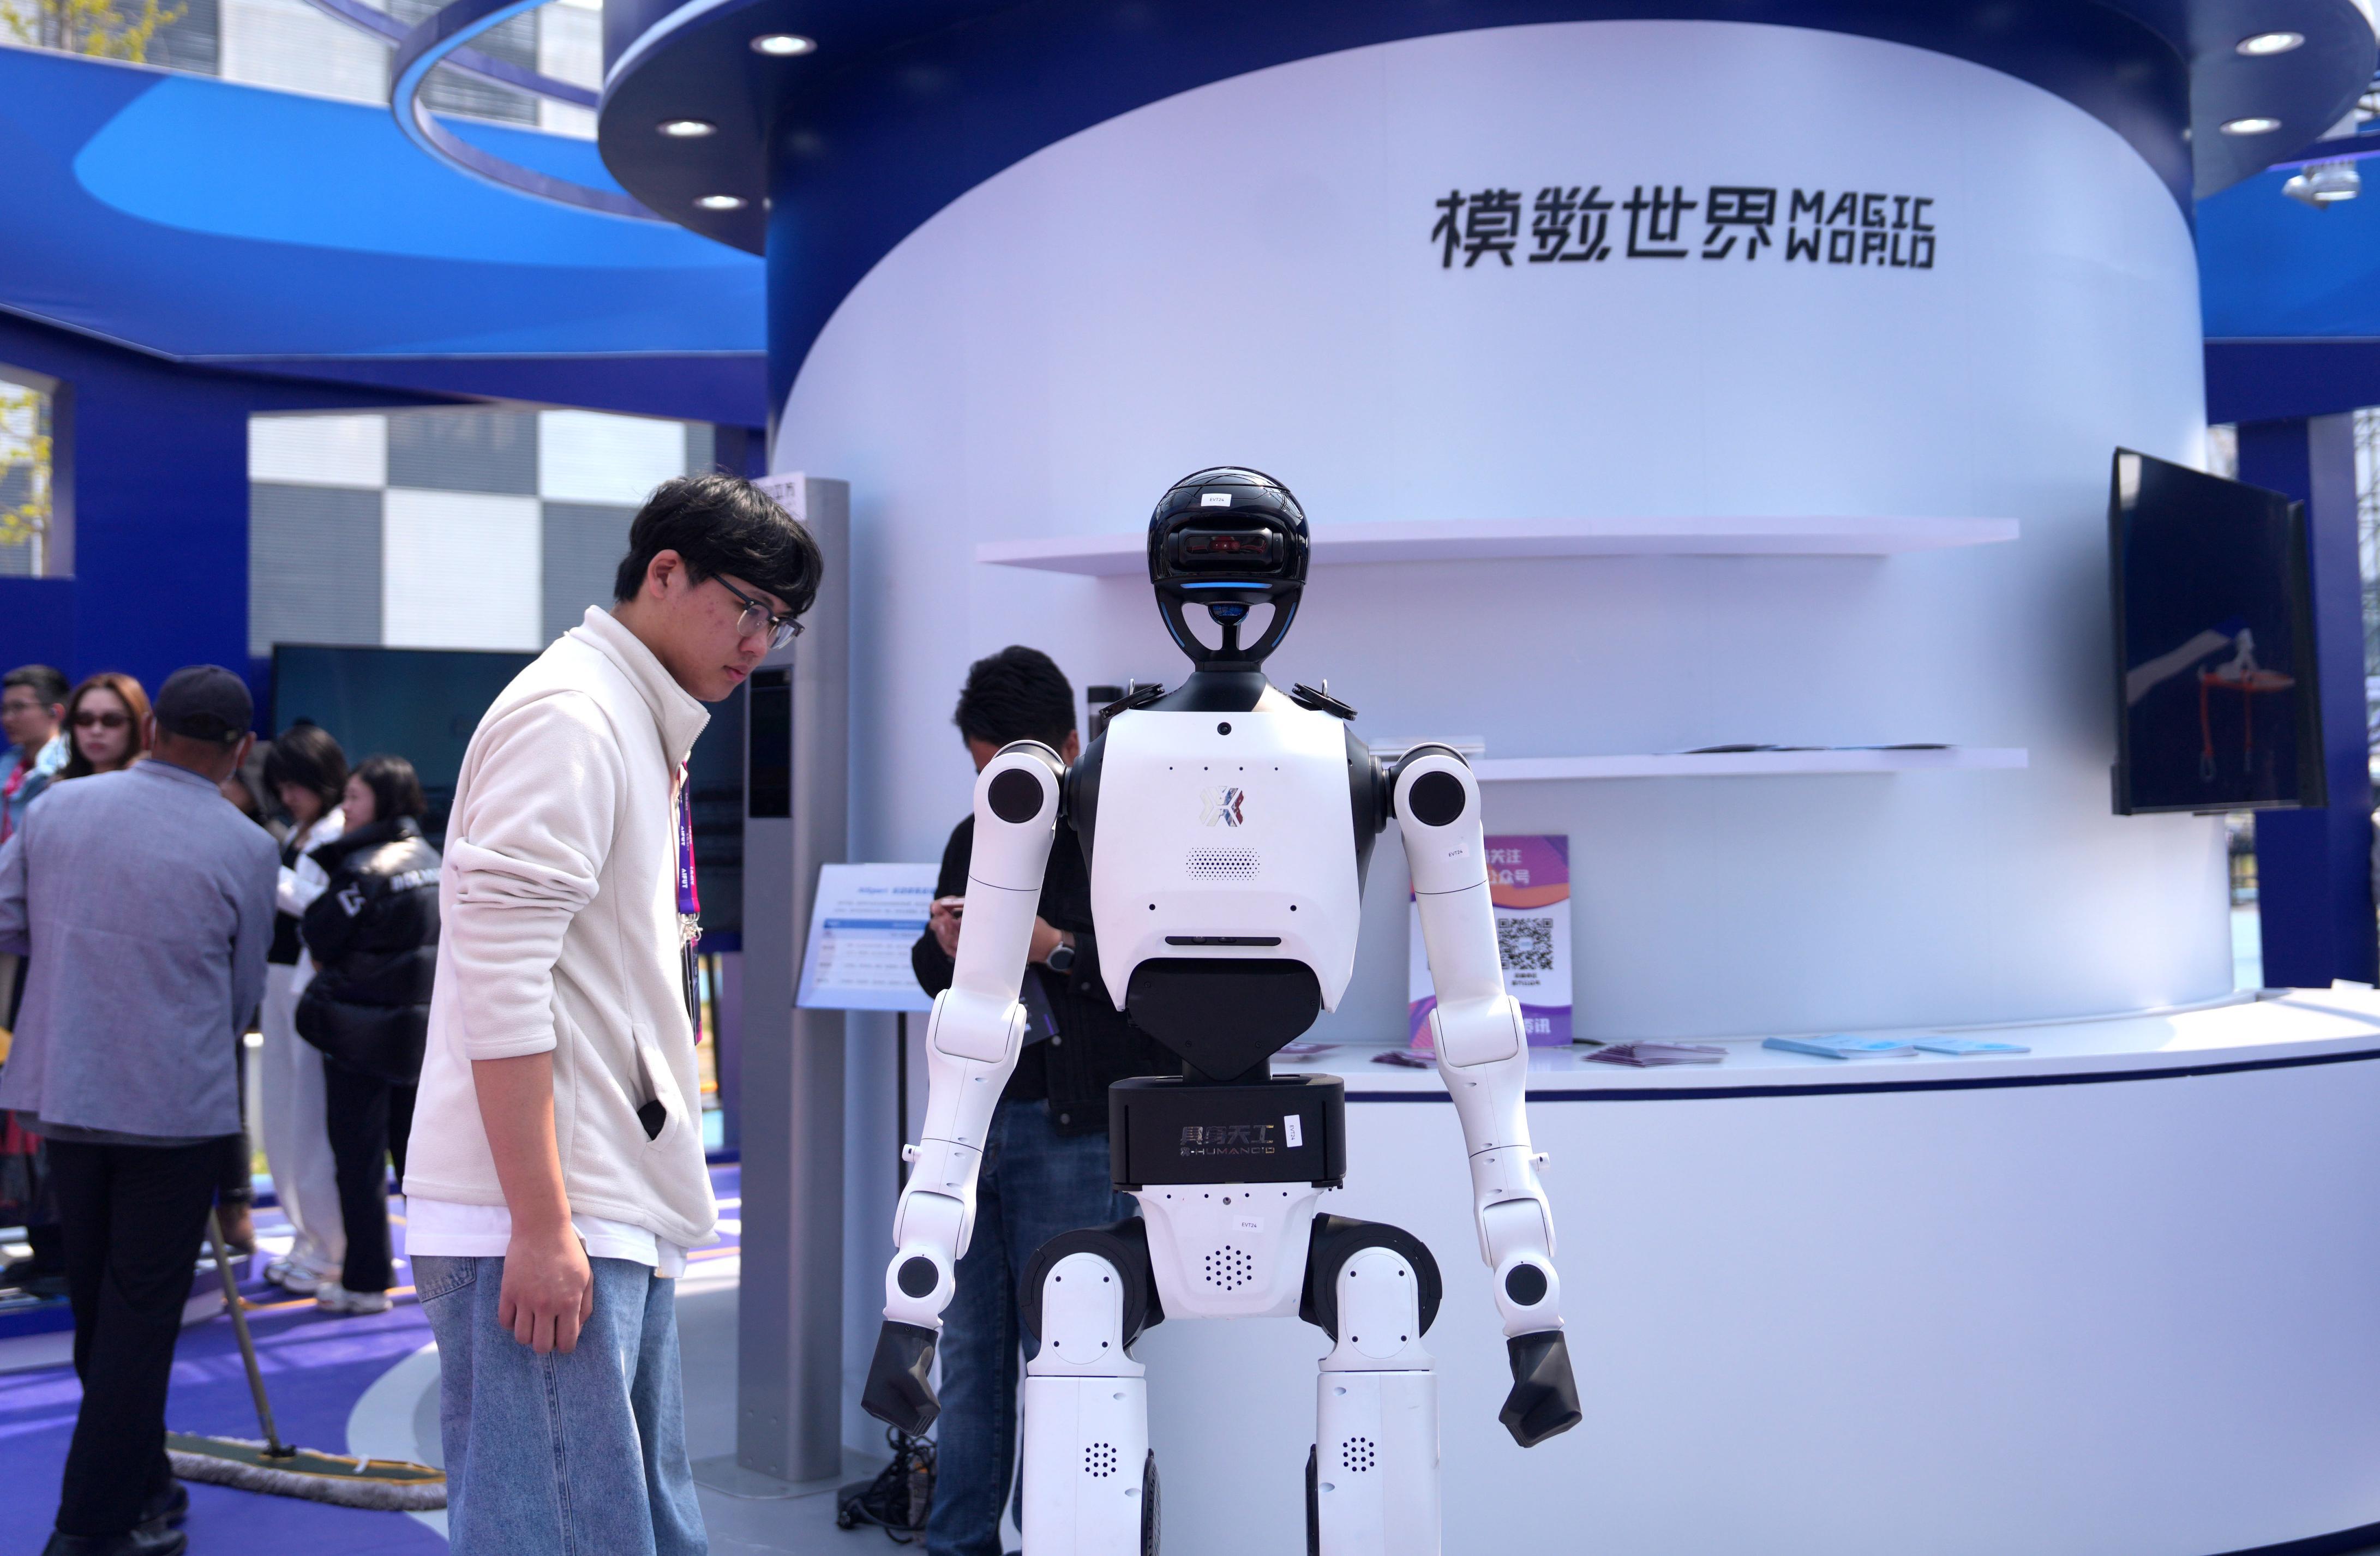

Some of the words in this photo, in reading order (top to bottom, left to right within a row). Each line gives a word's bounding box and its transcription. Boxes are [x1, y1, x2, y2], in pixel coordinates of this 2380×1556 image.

[1431, 185, 1777, 268] 模数世界
[1788, 188, 1935, 232] MAGIC
[1785, 226, 1935, 269] WORLD
[1180, 1125, 1274, 1145] 具身天工
